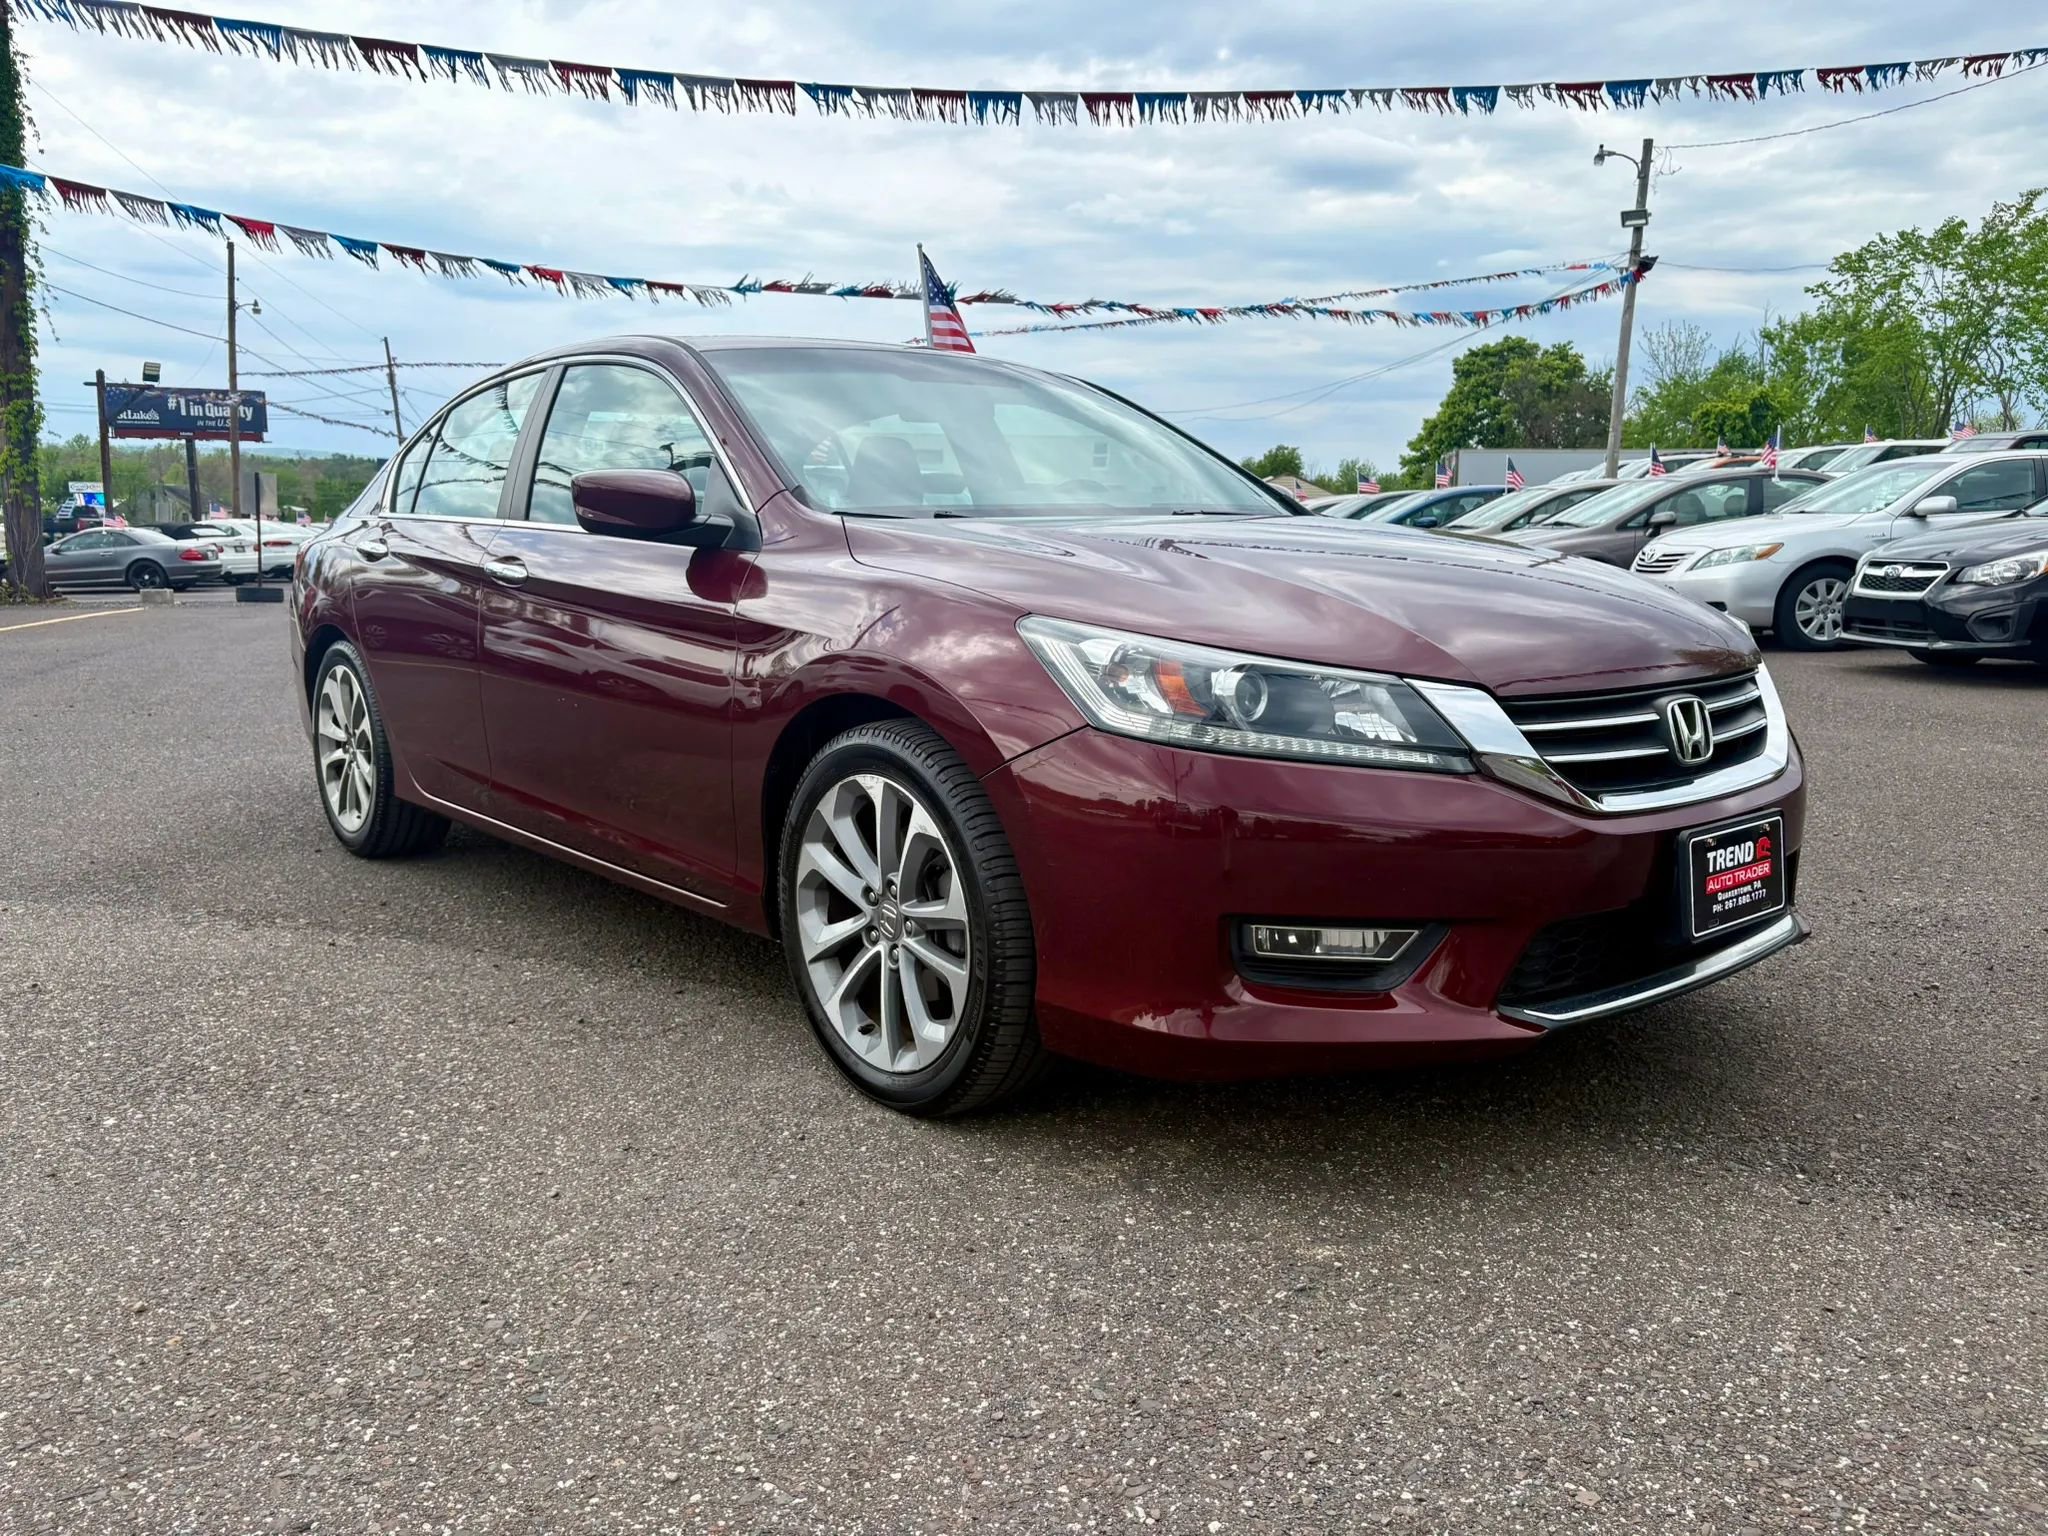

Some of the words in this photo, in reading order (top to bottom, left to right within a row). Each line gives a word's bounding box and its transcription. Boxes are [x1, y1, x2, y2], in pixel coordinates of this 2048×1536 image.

[168, 394, 186, 416] #1
[190, 401, 203, 417] in
[205, 402, 253, 421] Quaty
[1706, 840, 1754, 873] TREND
[1707, 873, 1733, 892] AUTO
[1734, 862, 1770, 883] TRADER
[1753, 880, 1762, 890] PA
[1712, 903, 1724, 914] PH:
